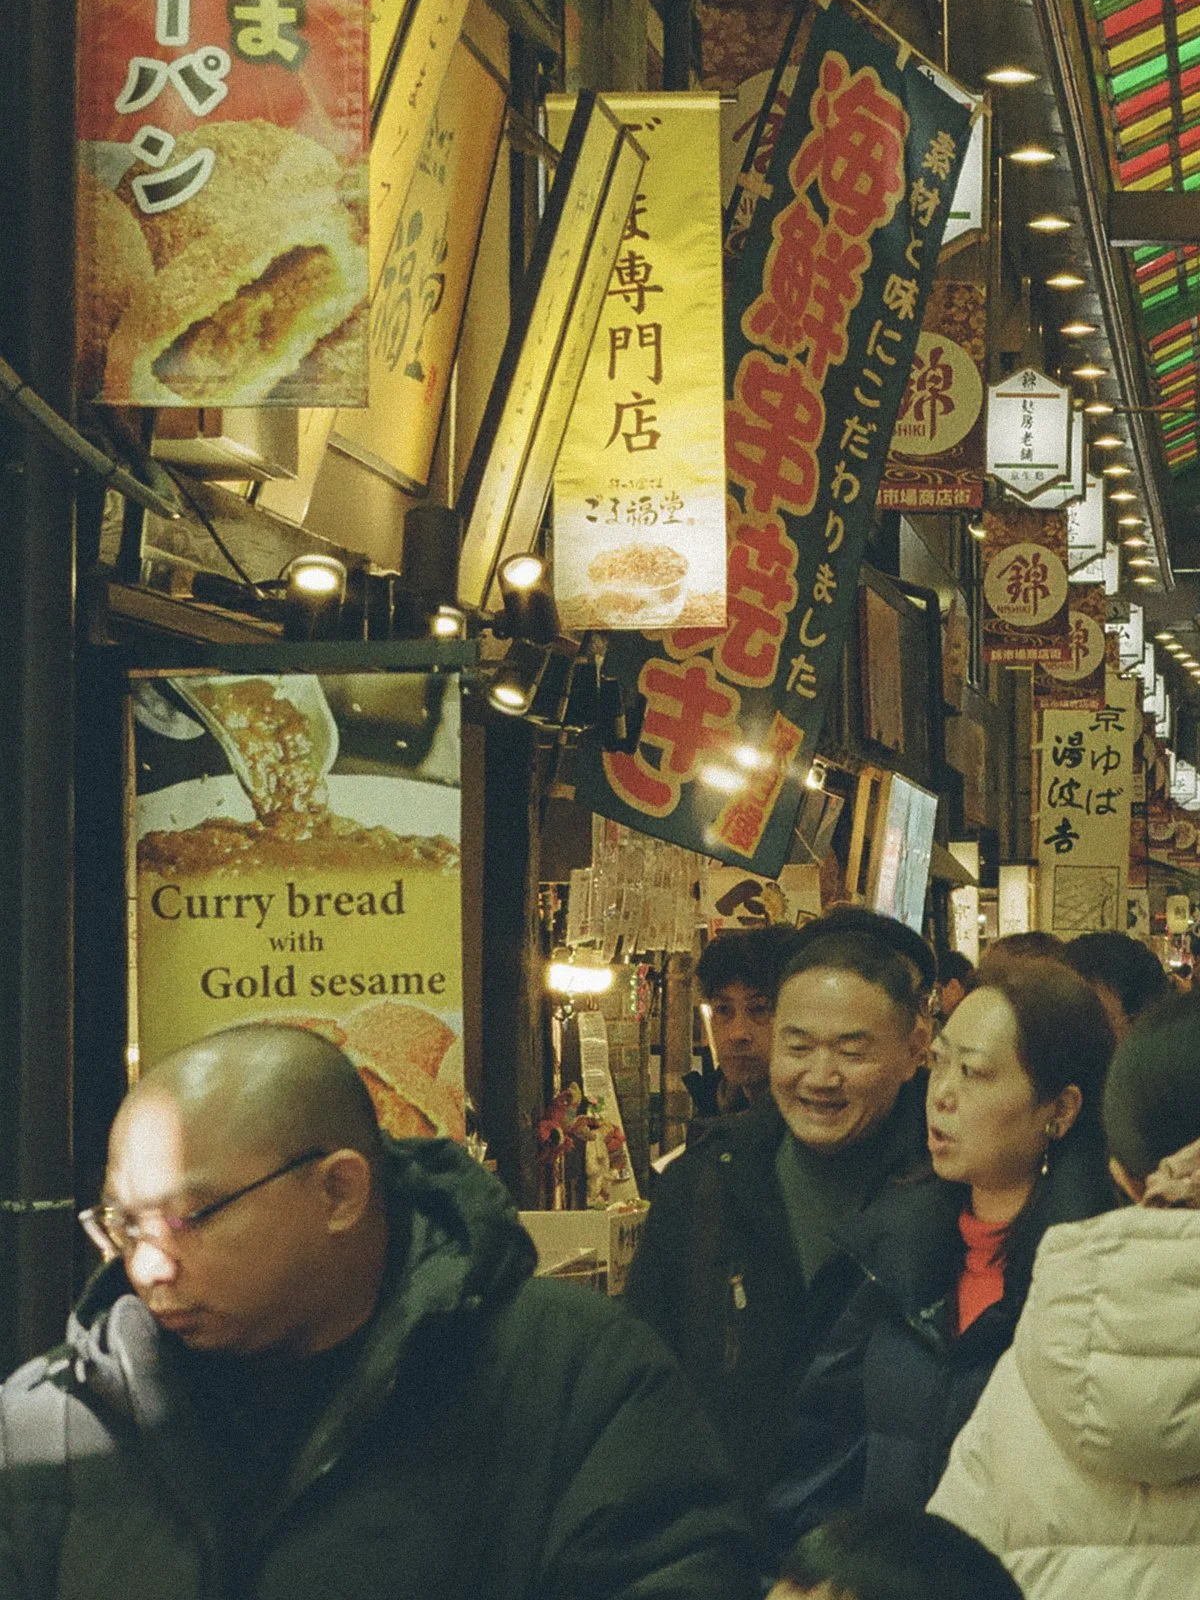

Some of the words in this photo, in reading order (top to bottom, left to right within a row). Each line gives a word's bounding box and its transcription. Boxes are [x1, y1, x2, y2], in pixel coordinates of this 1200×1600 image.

[786, 131, 956, 699] 素材と味にこだわりました
[896, 424, 926, 437] HIKI
[584, 491, 685, 526] ごま福堂
[877, 488, 971, 507] 市場商店街
[997, 552, 1050, 616] 錦
[1088, 704, 1126, 815] 京ゆば
[1043, 731, 1086, 854] 湯波吉
[151, 884, 276, 929] Curry
[287, 879, 405, 918] bread
[269, 930, 324, 954] with
[201, 966, 296, 999] Gold
[310, 970, 446, 998] sesame
